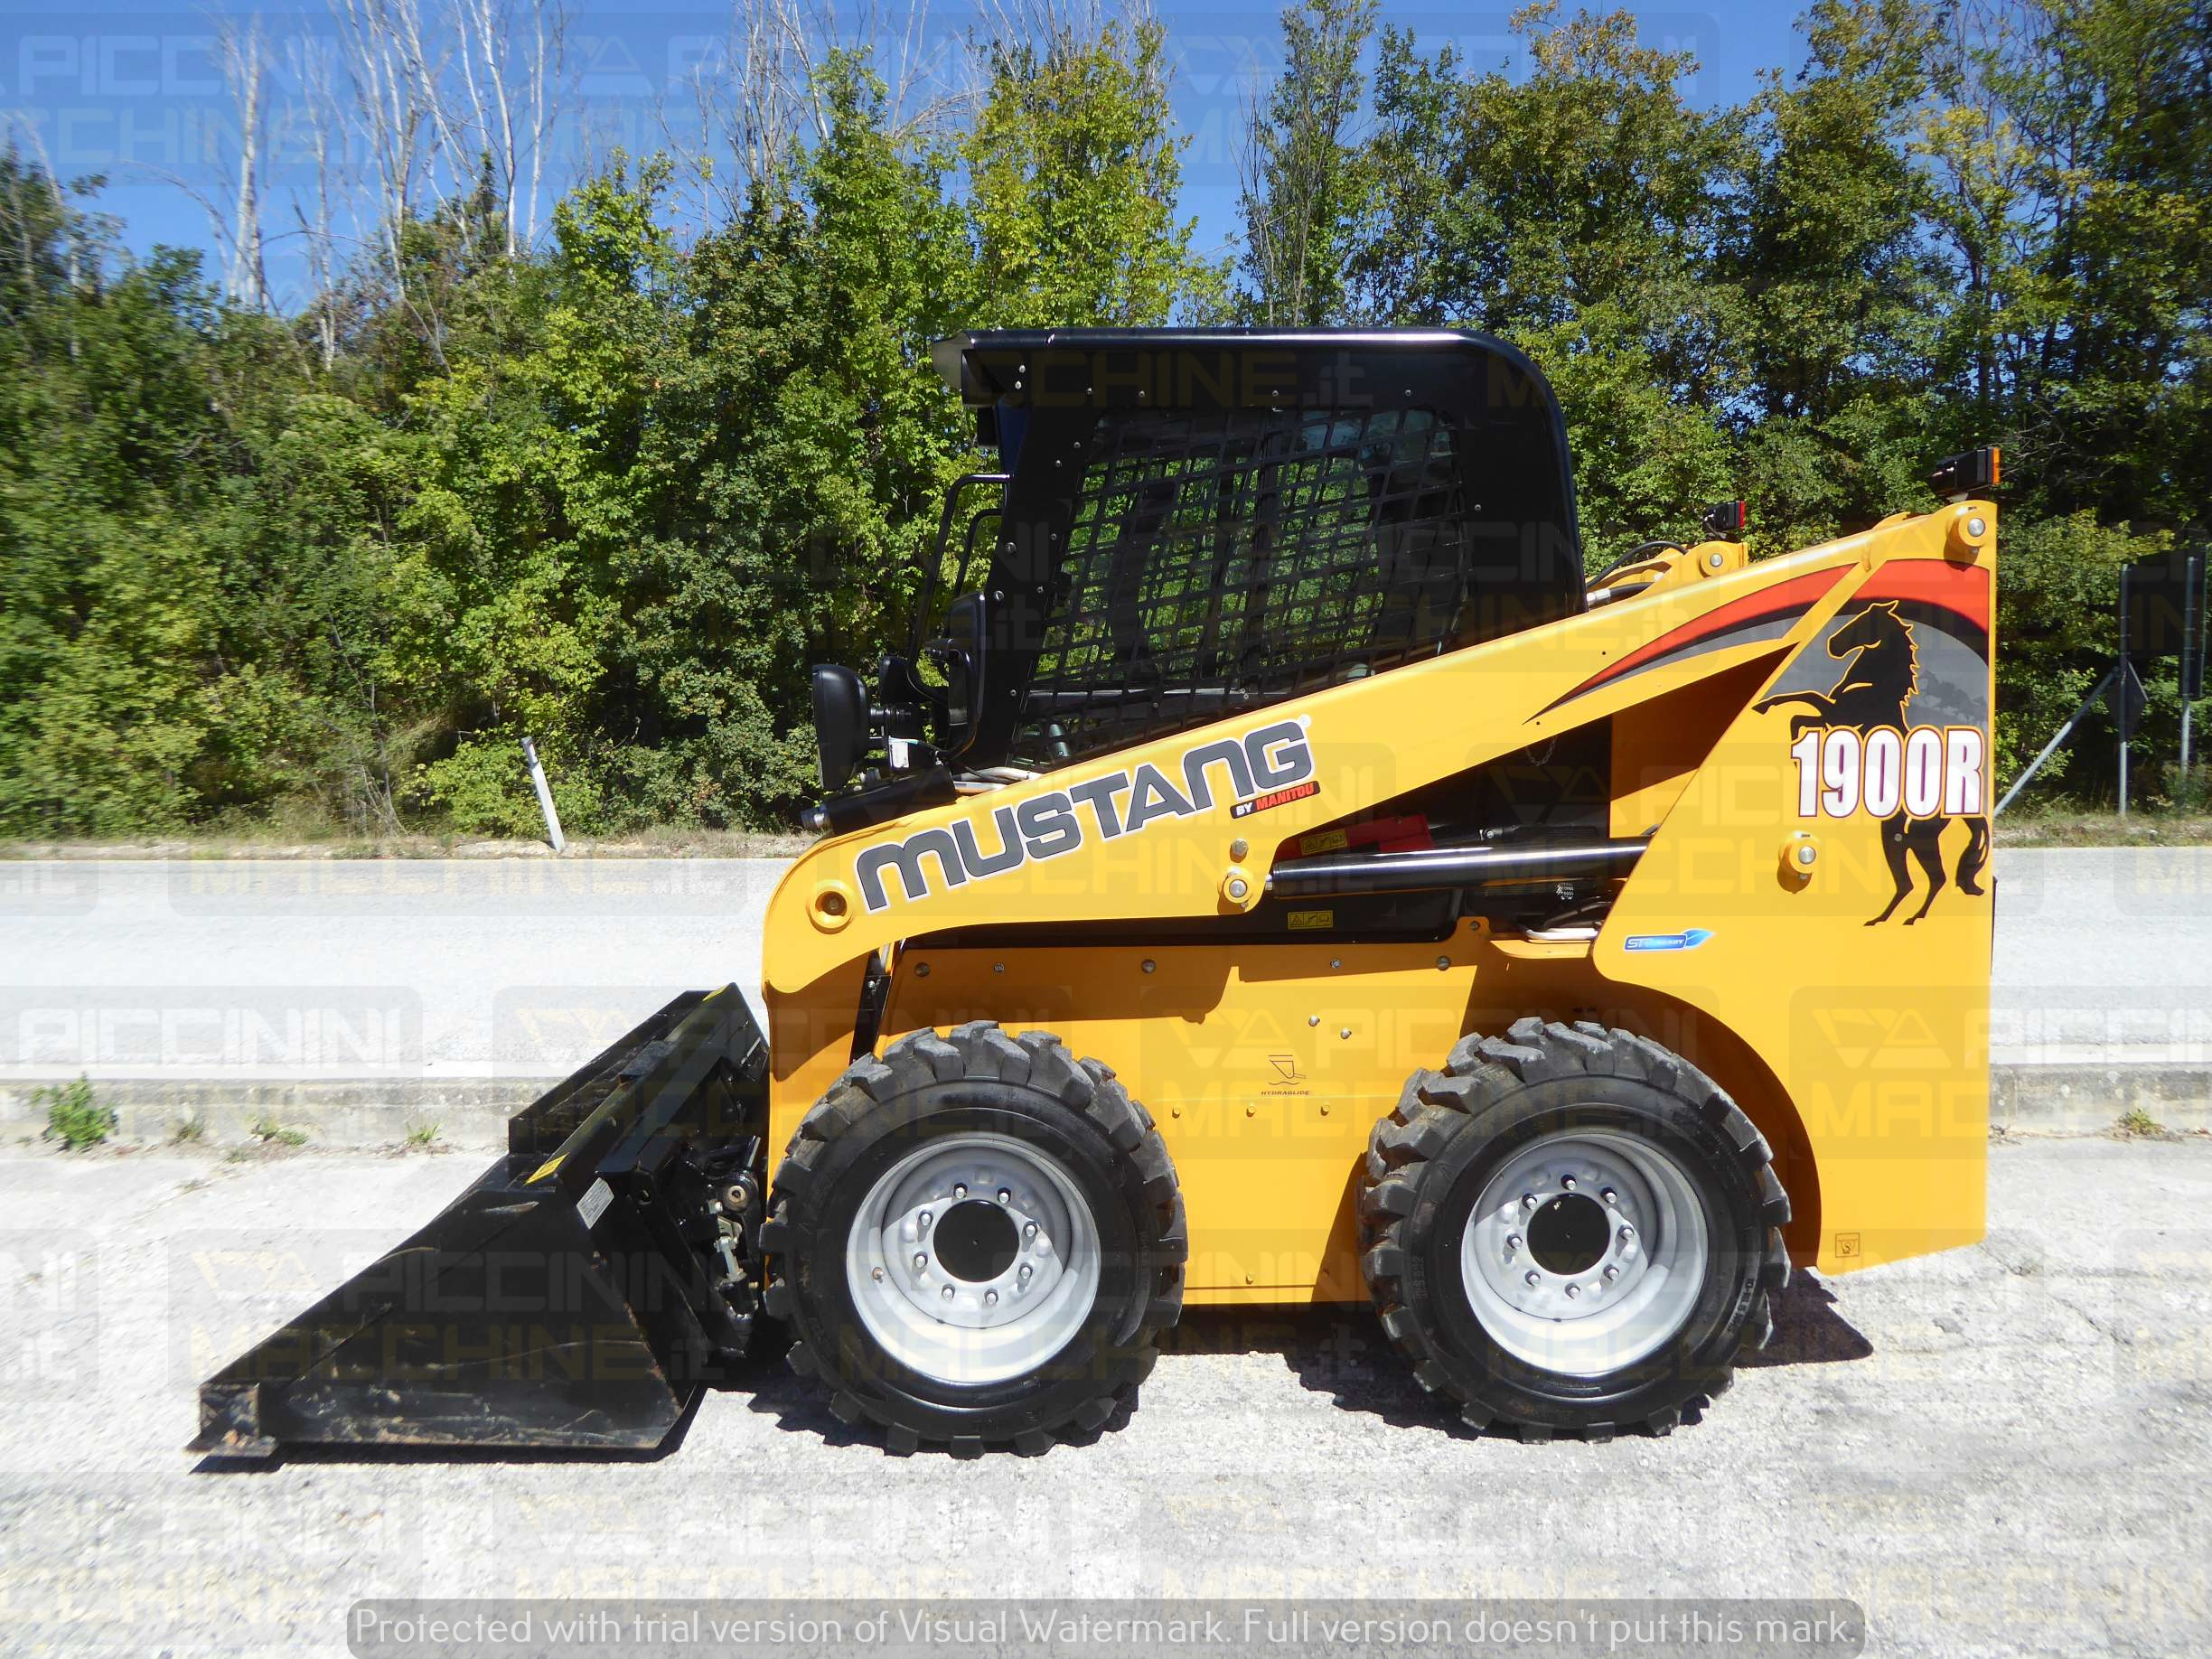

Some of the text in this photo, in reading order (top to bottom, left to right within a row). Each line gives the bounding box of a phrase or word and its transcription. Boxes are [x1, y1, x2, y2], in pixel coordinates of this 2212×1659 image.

[855, 720, 1314, 912] MUSTANG
[1235, 783, 1315, 816] BY MANITOU
[1790, 726, 1983, 818] 1900R
